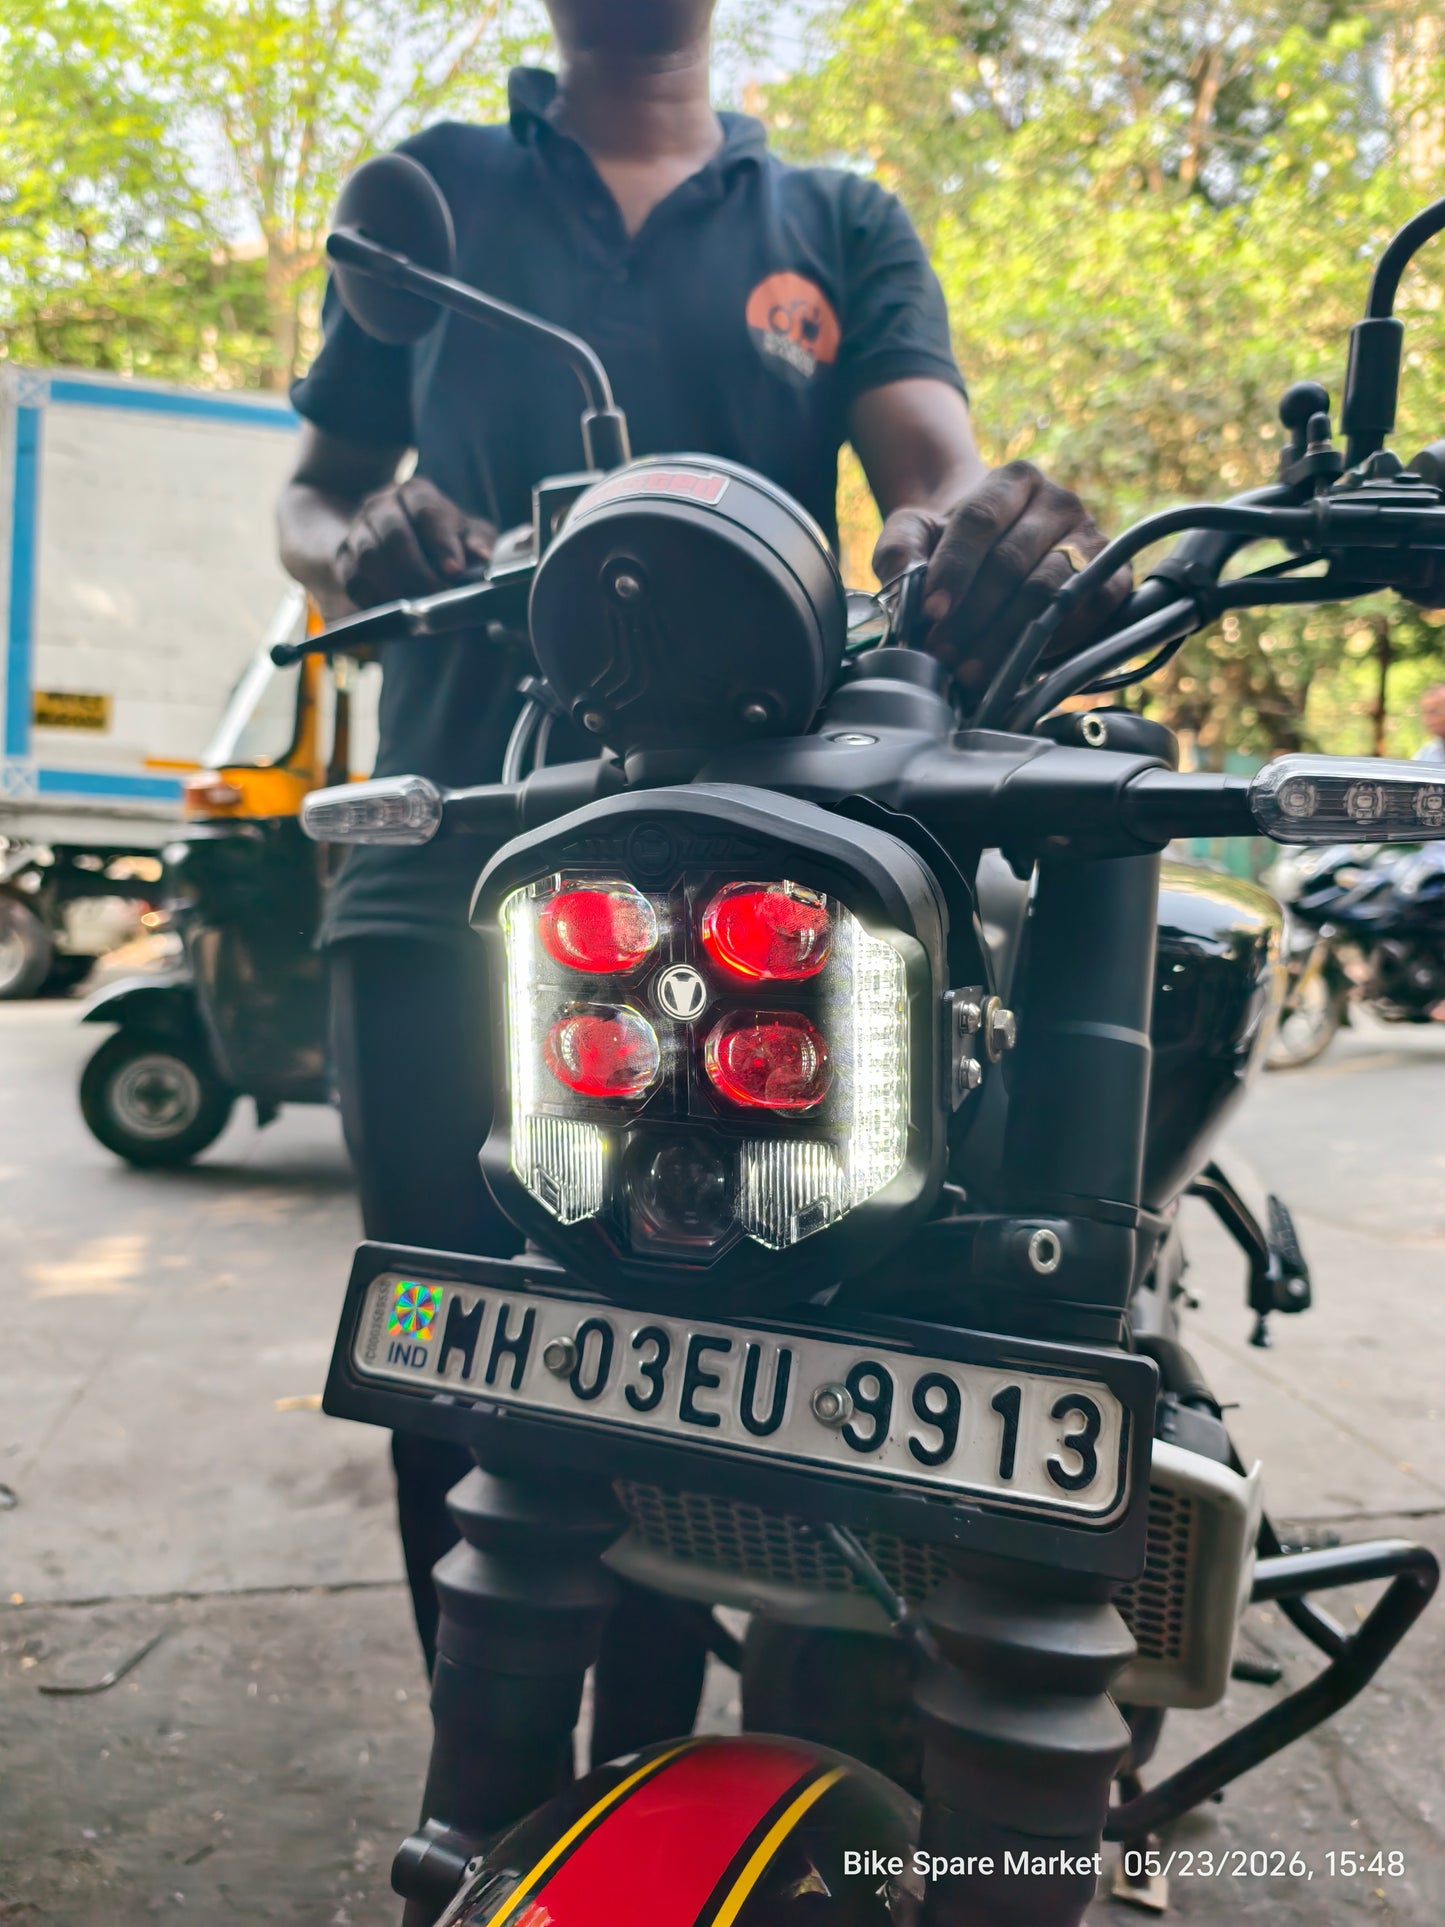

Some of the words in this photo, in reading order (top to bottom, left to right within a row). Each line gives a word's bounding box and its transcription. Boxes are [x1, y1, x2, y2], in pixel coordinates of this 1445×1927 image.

[387, 1341, 428, 1369] IND
[437, 1293, 537, 1390] MH
[569, 1317, 792, 1437] 03EU
[841, 1360, 1102, 1491] 9913
